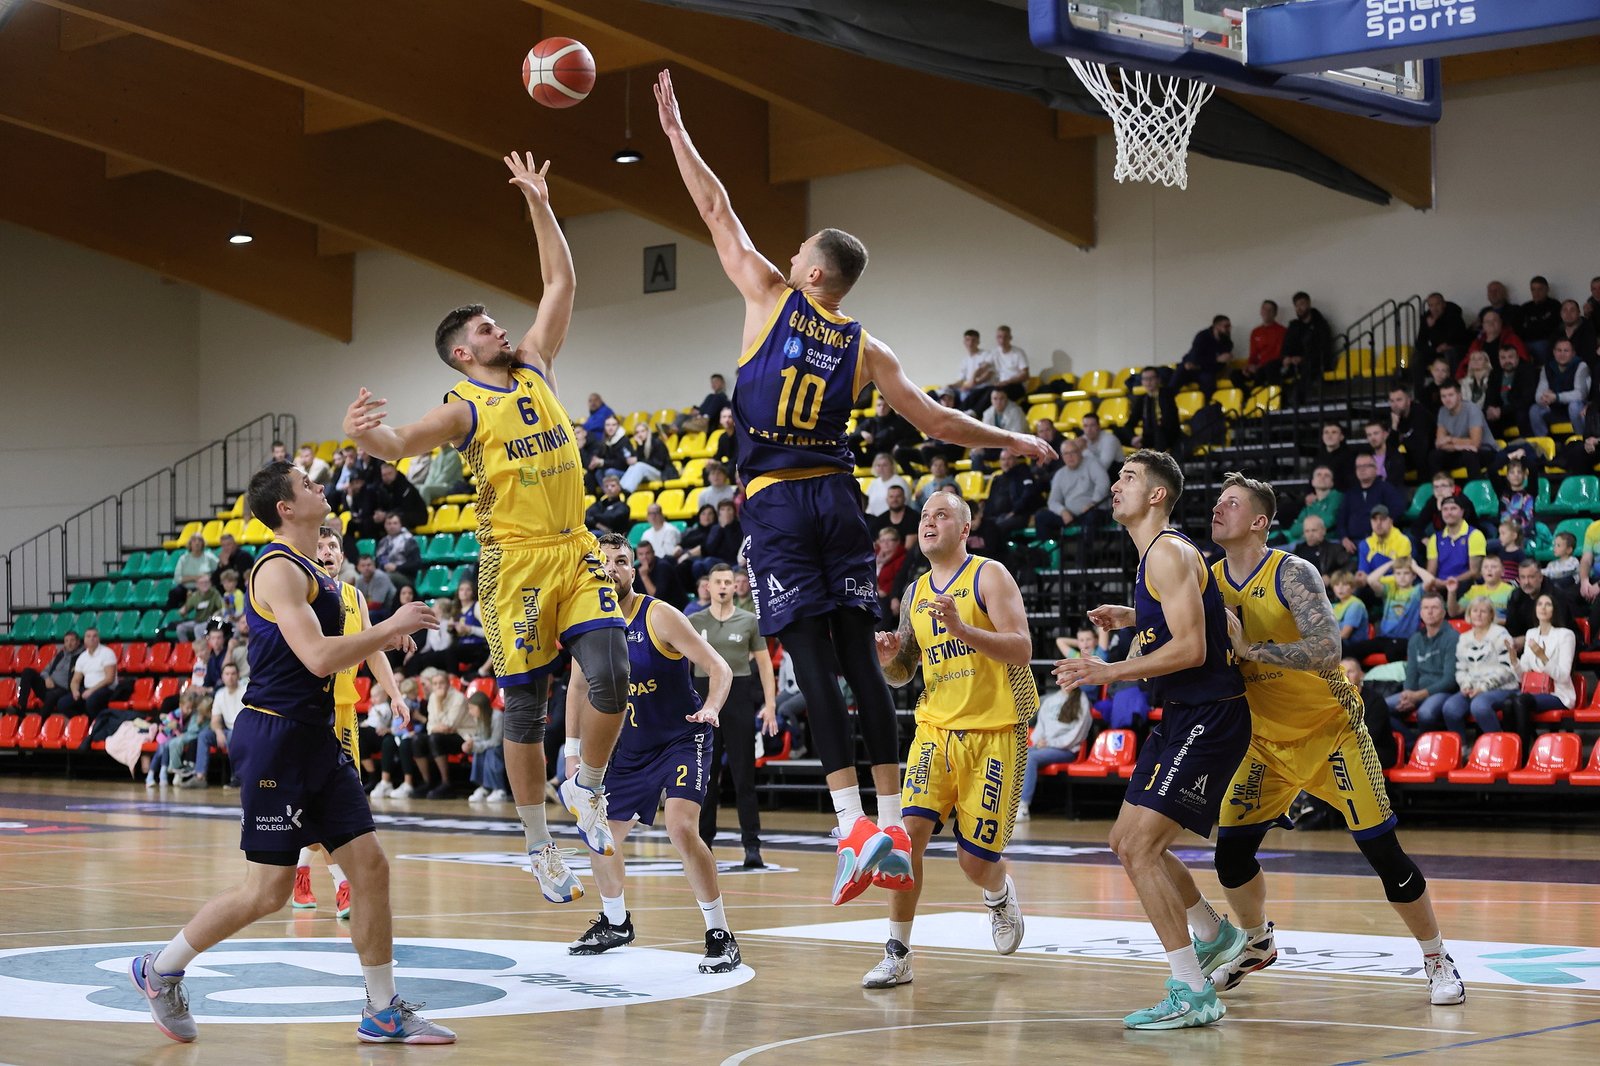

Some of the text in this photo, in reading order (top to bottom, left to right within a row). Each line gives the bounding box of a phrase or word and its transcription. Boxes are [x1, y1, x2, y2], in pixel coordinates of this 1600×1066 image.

[1366, 6, 1476, 40] Sports
[650, 253, 670, 284] A
[776, 365, 827, 431] 10
[517, 396, 540, 425] 6
[541, 460, 576, 478] eskolos
[598, 587, 616, 612] 6
[513, 621, 527, 635] VR
[938, 668, 976, 683] eskolos
[676, 765, 688, 787] 2
[1232, 783, 1246, 796] VR
[256, 815, 283, 823] KAUNO
[1346, 798, 1360, 825] 1
[256, 824, 293, 832] KOLEGIJA
[973, 816, 999, 845] 13
